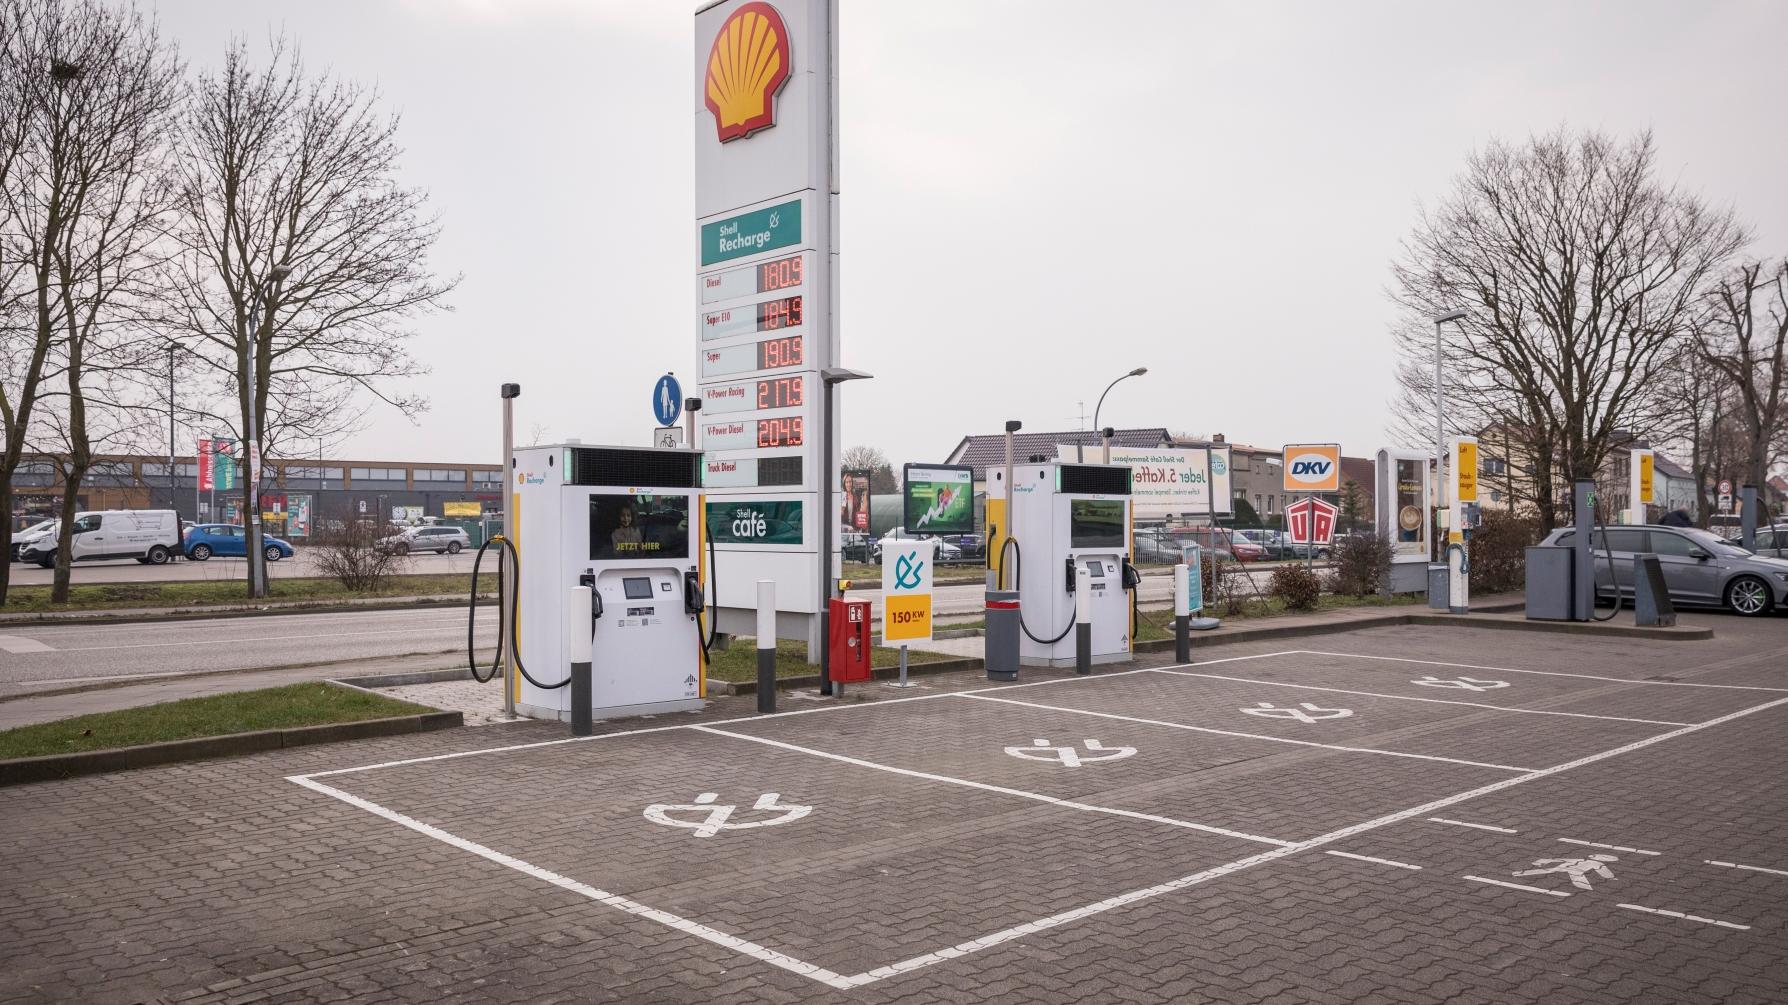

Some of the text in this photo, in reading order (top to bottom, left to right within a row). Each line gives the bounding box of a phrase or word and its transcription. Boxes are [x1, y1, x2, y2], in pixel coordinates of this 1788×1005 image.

[720, 222, 738, 237] Shell
[720, 230, 771, 253] Recharge
[763, 258, 803, 291] 180.9
[706, 277, 722, 288] Diesel
[706, 311, 731, 325] Super E10
[764, 297, 803, 330] 184.9
[706, 352, 721, 363] Super
[764, 337, 803, 369] 190.9
[707, 387, 745, 399] V-Power Racing
[758, 380, 803, 409] 217.9
[707, 424, 744, 436] V-Power Diesel
[758, 418, 803, 447] 204.9
[708, 461, 737, 473] Truck Diesel
[1292, 462, 1332, 475] DKV
[736, 508, 750, 518] Shell
[732, 512, 766, 537] café
[616, 542, 660, 551] JETZT HIER
[892, 610, 924, 624] 150 KW
